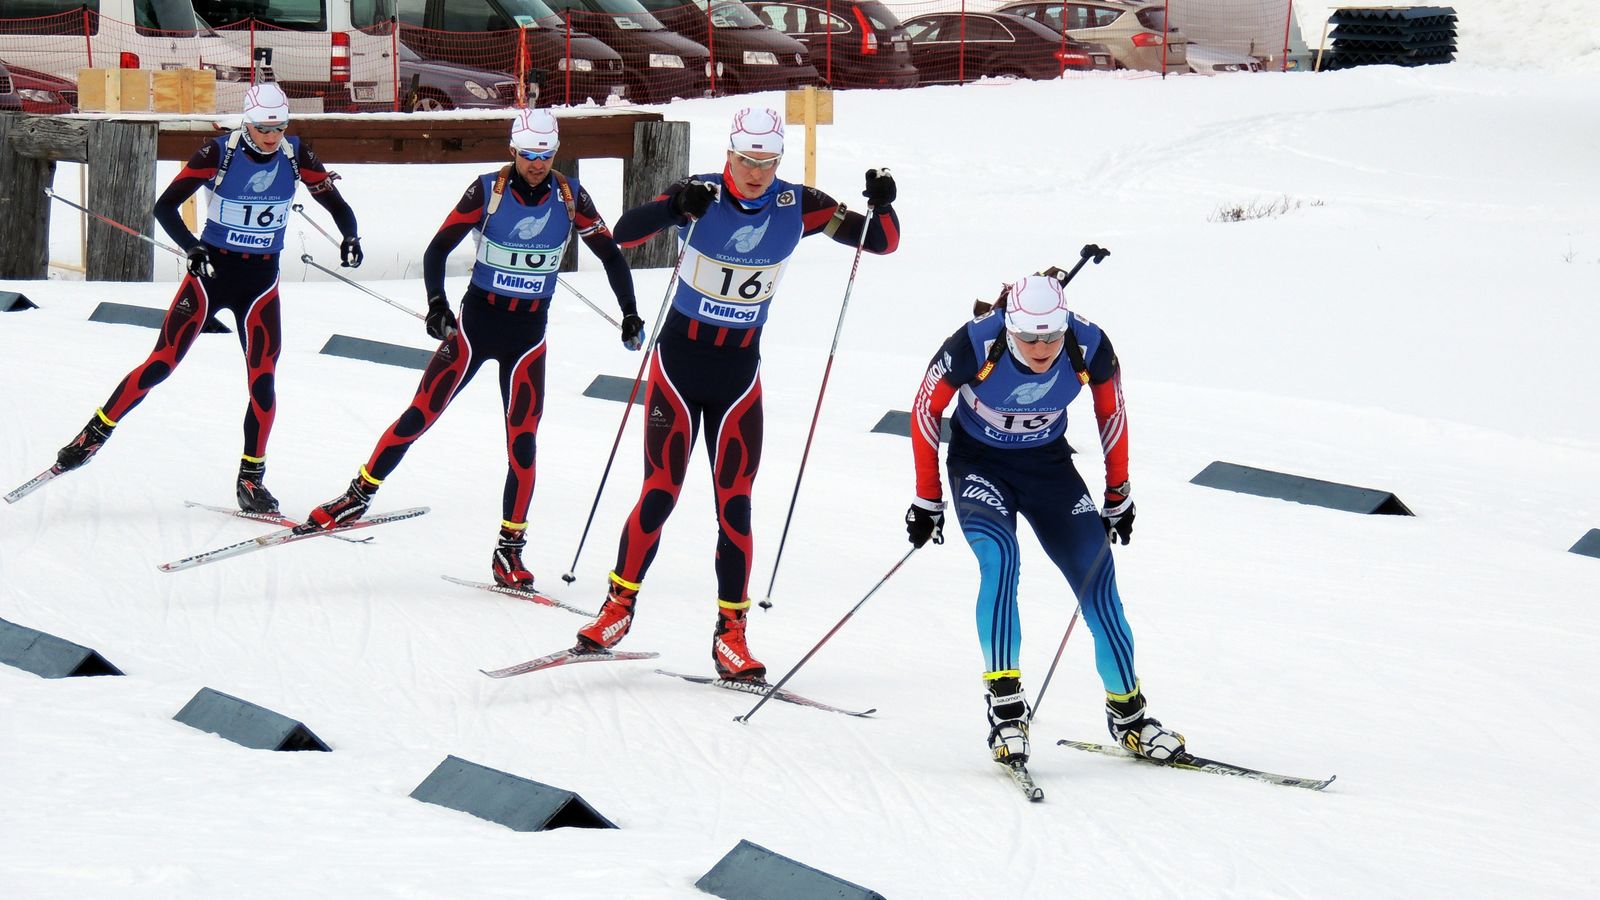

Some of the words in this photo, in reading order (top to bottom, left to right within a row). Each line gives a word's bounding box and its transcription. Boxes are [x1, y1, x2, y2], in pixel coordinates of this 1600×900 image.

[243, 205, 274, 227] 16
[230, 232, 272, 246] Millog
[496, 273, 543, 292] Millog
[720, 268, 763, 299] 16
[764, 281, 773, 294] 3
[703, 302, 756, 321] Millog
[923, 359, 947, 396] LUKOIL
[1002, 415, 1049, 430] 16
[961, 485, 1009, 516] LUKOIL
[237, 510, 282, 523] MADSHUS
[369, 510, 426, 524] MADSHUS
[1071, 505, 1098, 515] adida
[491, 585, 535, 599] MADSHUS
